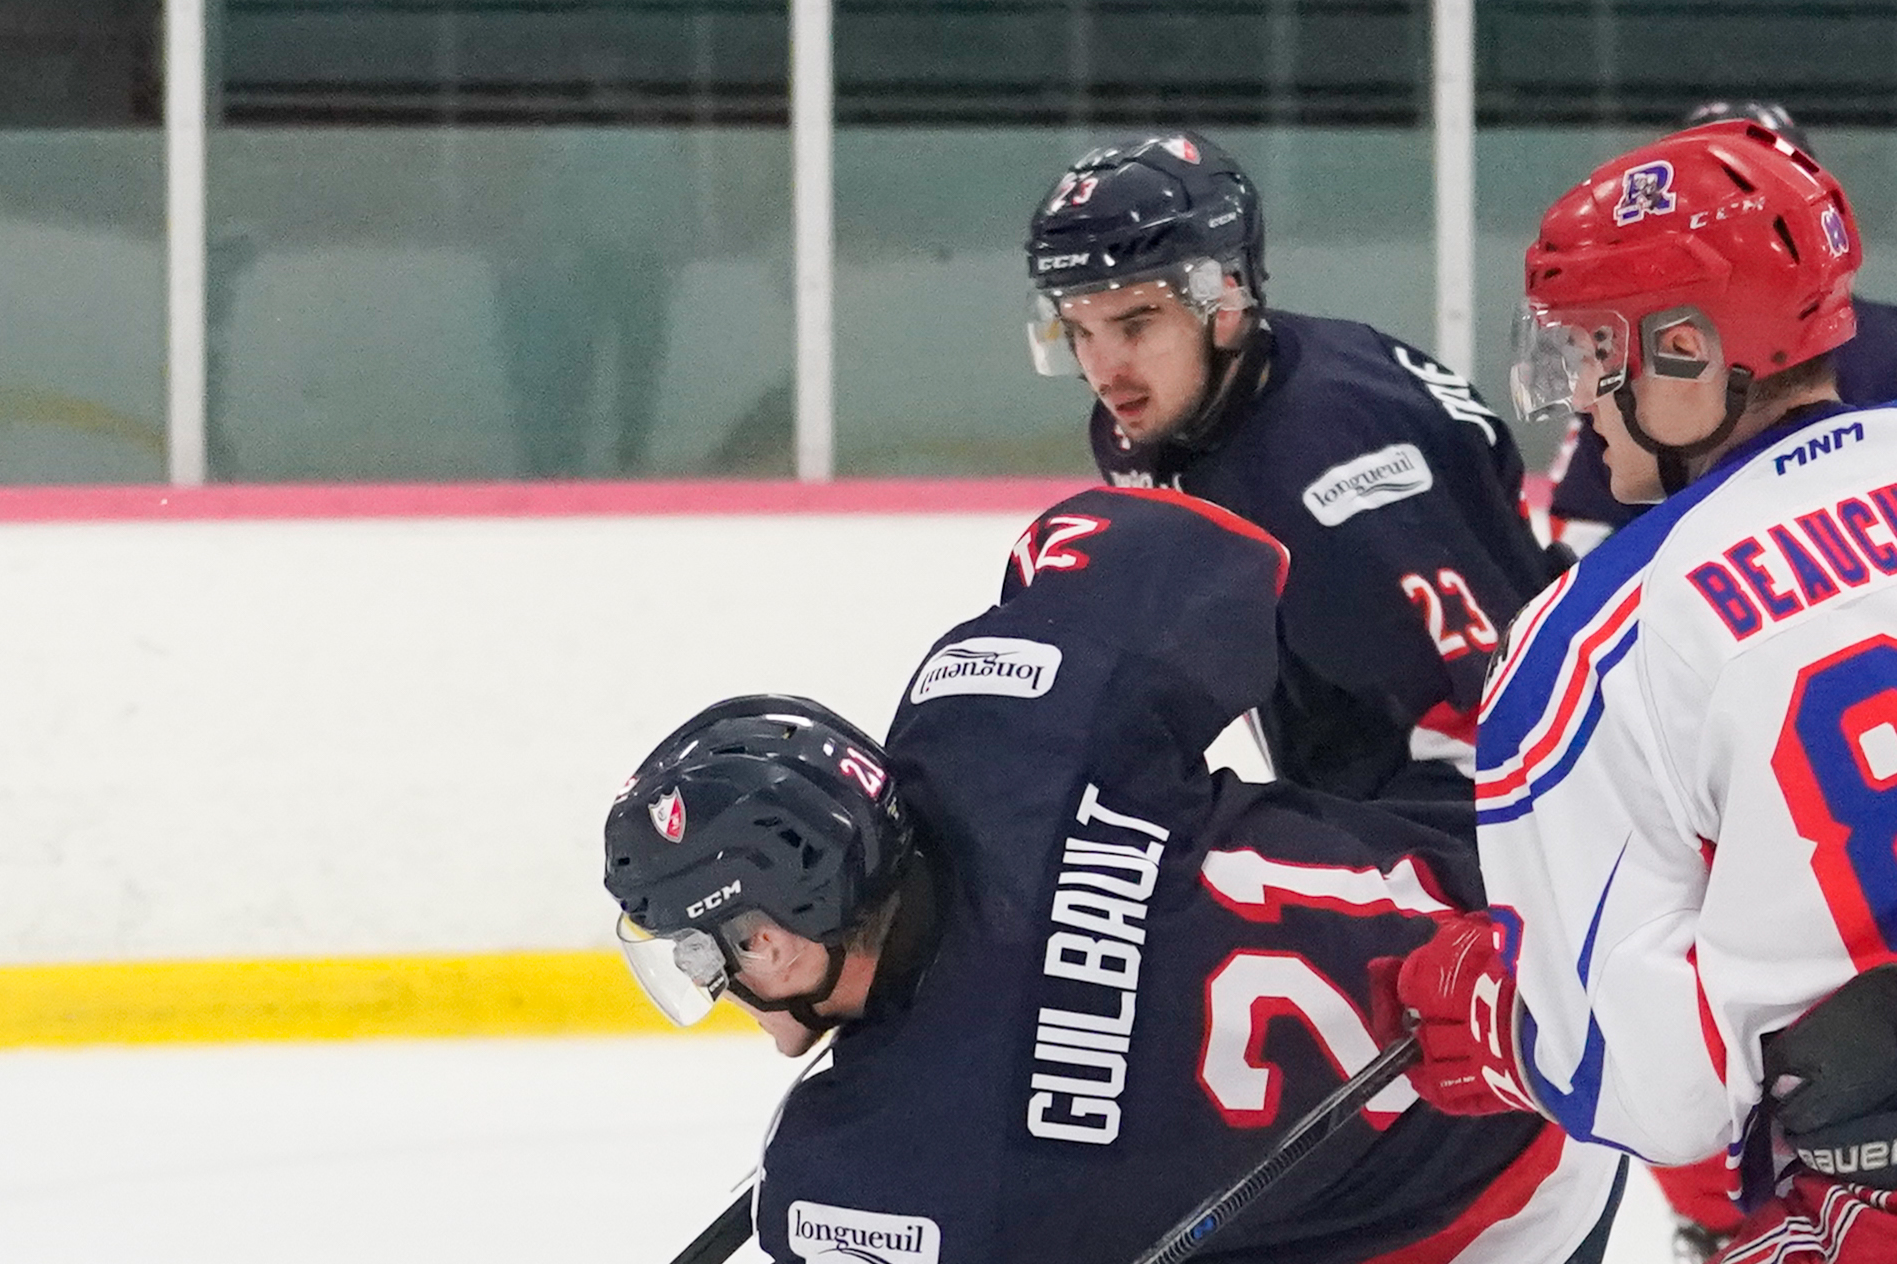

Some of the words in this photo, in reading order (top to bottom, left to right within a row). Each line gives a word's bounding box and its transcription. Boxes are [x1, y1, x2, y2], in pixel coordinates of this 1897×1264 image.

[1038, 252, 1091, 271] CCM
[1773, 422, 1865, 476] MNM
[1311, 450, 1416, 508] longueuil
[1401, 569, 1500, 662] 23
[918, 655, 1046, 695] longueuil
[838, 746, 888, 800] 21
[685, 879, 743, 919] CCM
[1027, 782, 1171, 1146] GUILBAULT
[1195, 847, 1471, 1132] 21
[1796, 1136, 1897, 1175] BAUE
[795, 1208, 925, 1255] longueuil
